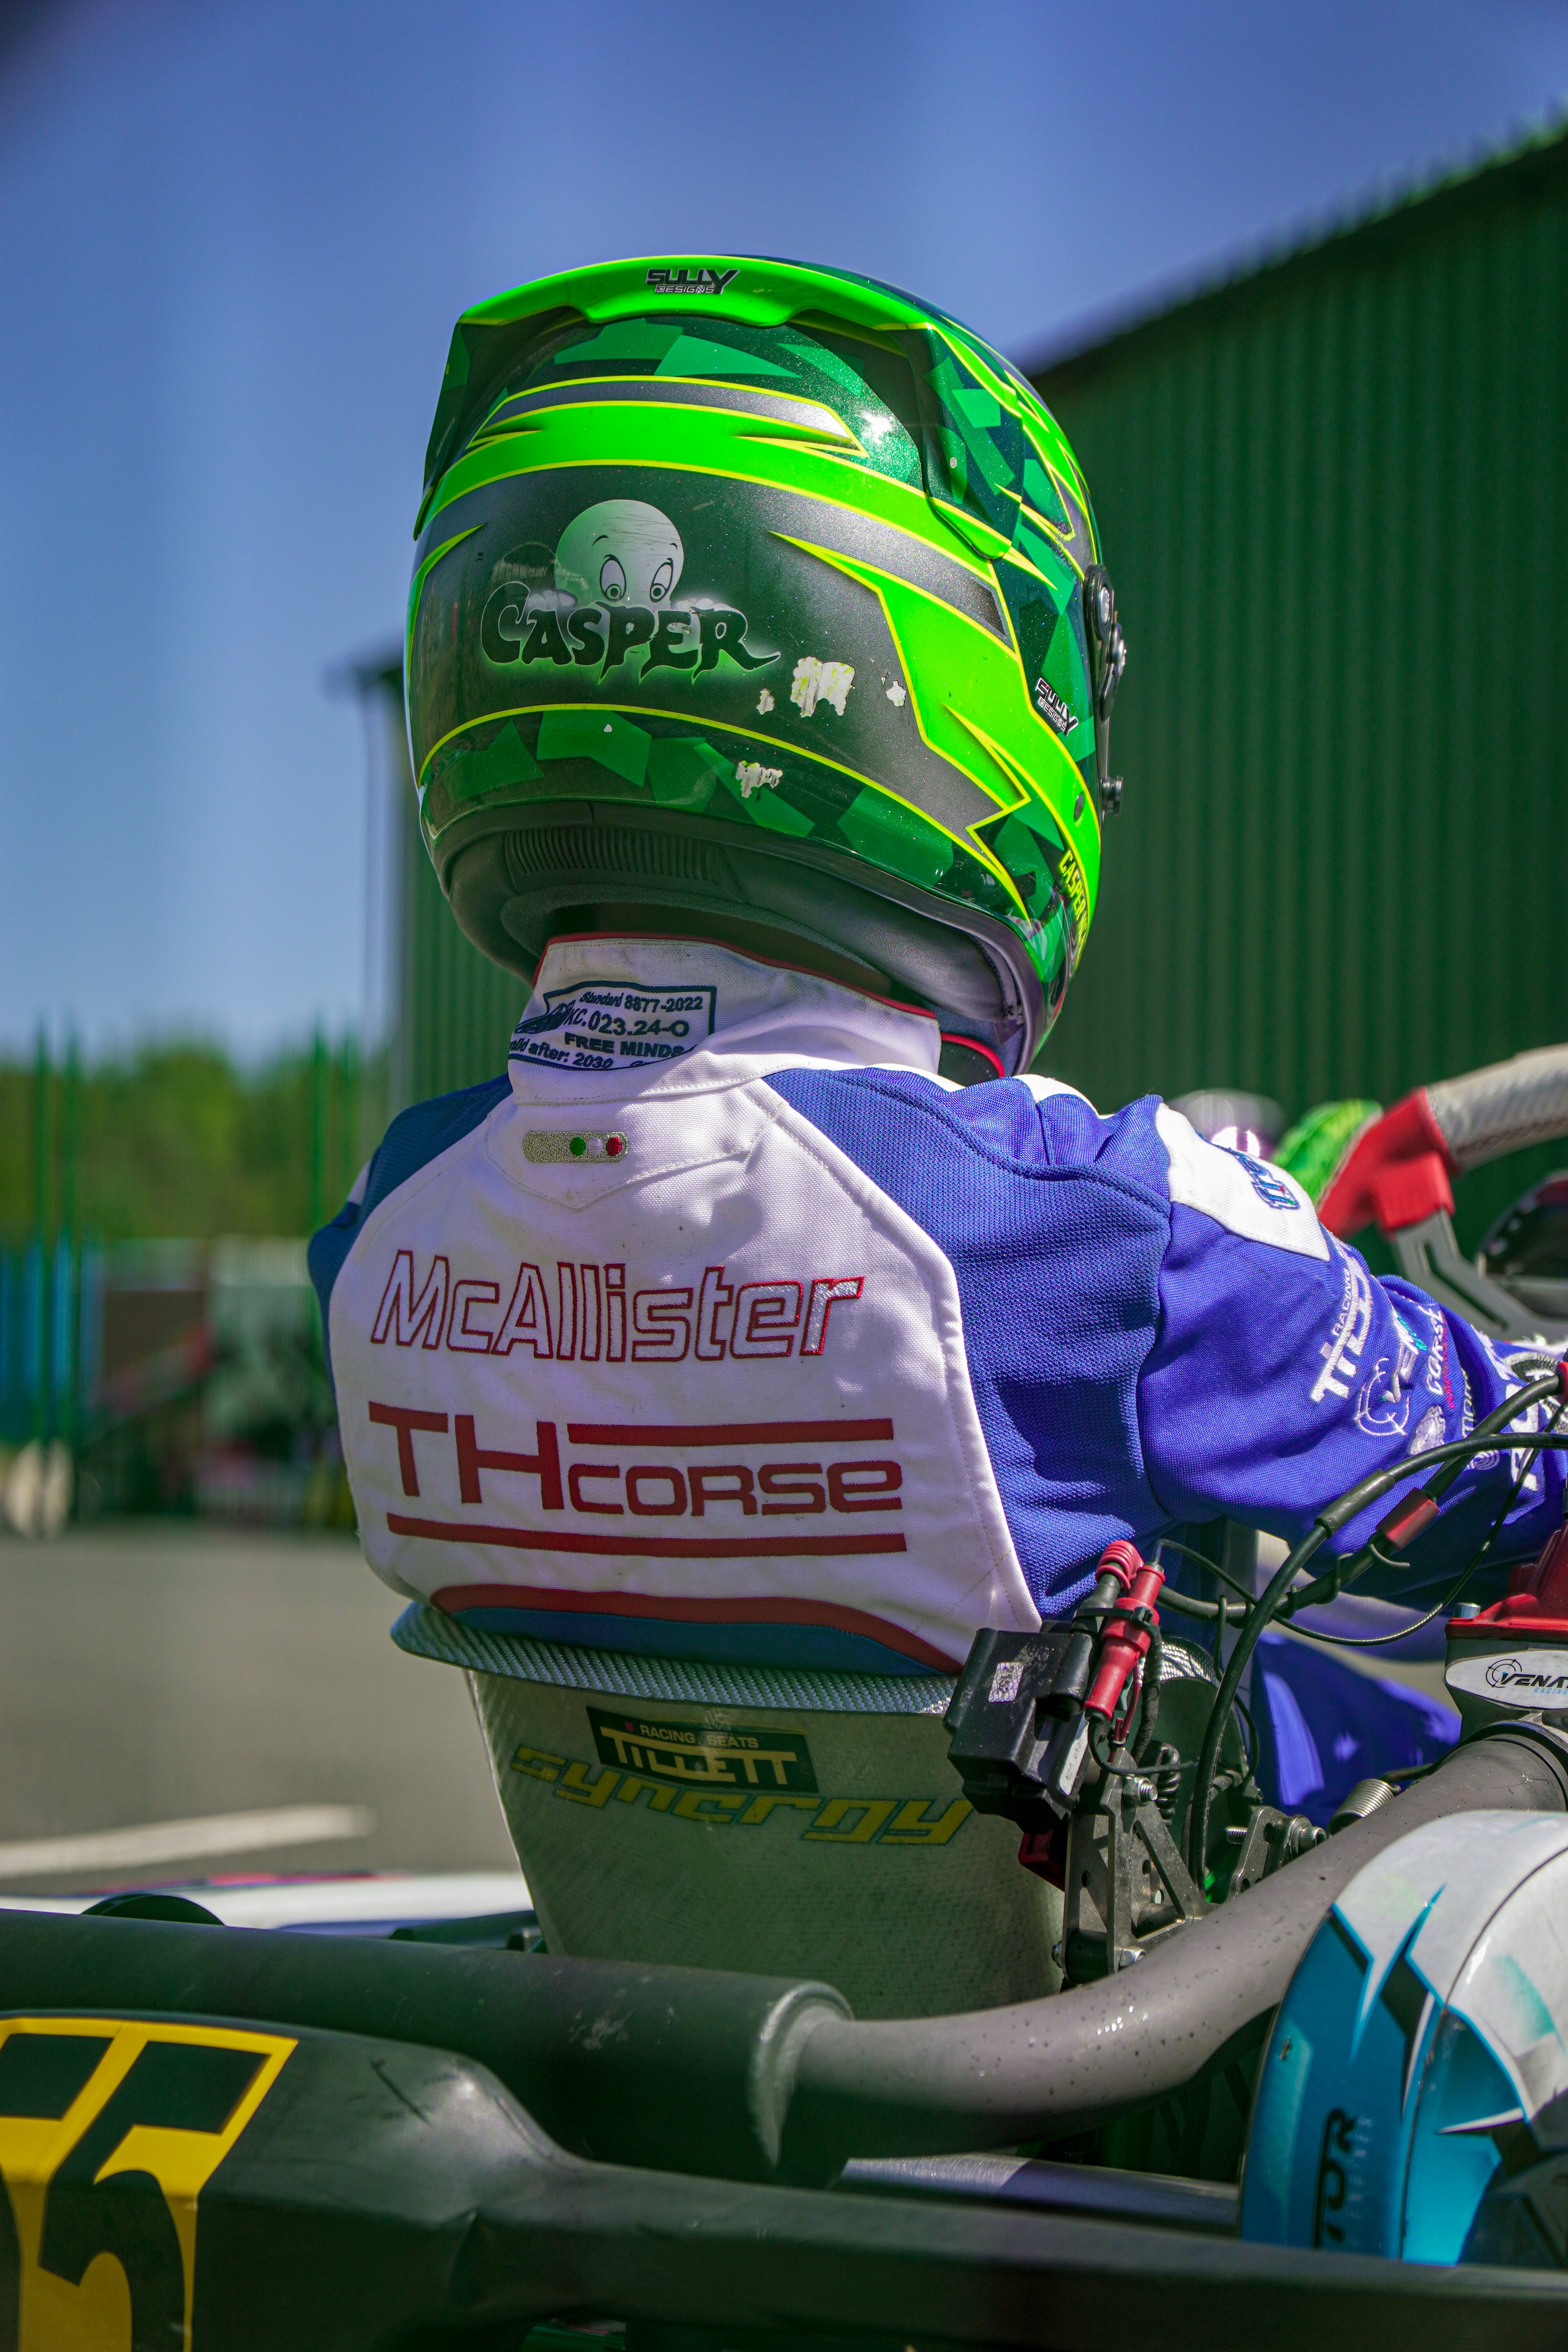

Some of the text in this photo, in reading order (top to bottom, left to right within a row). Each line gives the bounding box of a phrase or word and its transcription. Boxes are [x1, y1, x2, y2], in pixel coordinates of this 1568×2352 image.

[646, 269, 740, 295] SULLY
[655, 285, 715, 294] DESIGNS
[481, 581, 781, 686] CASPER
[1035, 677, 1079, 737] SULLY
[1038, 696, 1067, 733] DESIGNS
[1059, 849, 1086, 921] CASPER
[579, 991, 703, 1013] Standard 8877-2022
[564, 1032, 685, 1058] FREE MINDS
[371, 1249, 865, 1363] McAllister
[1500, 1672, 1568, 1689] VENA
[1534, 1686, 1568, 1695] RACING
[639, 1724, 759, 1749] RACING SEATS
[600, 1726, 797, 1785] TILLETT
[511, 1745, 975, 1845] synergy
